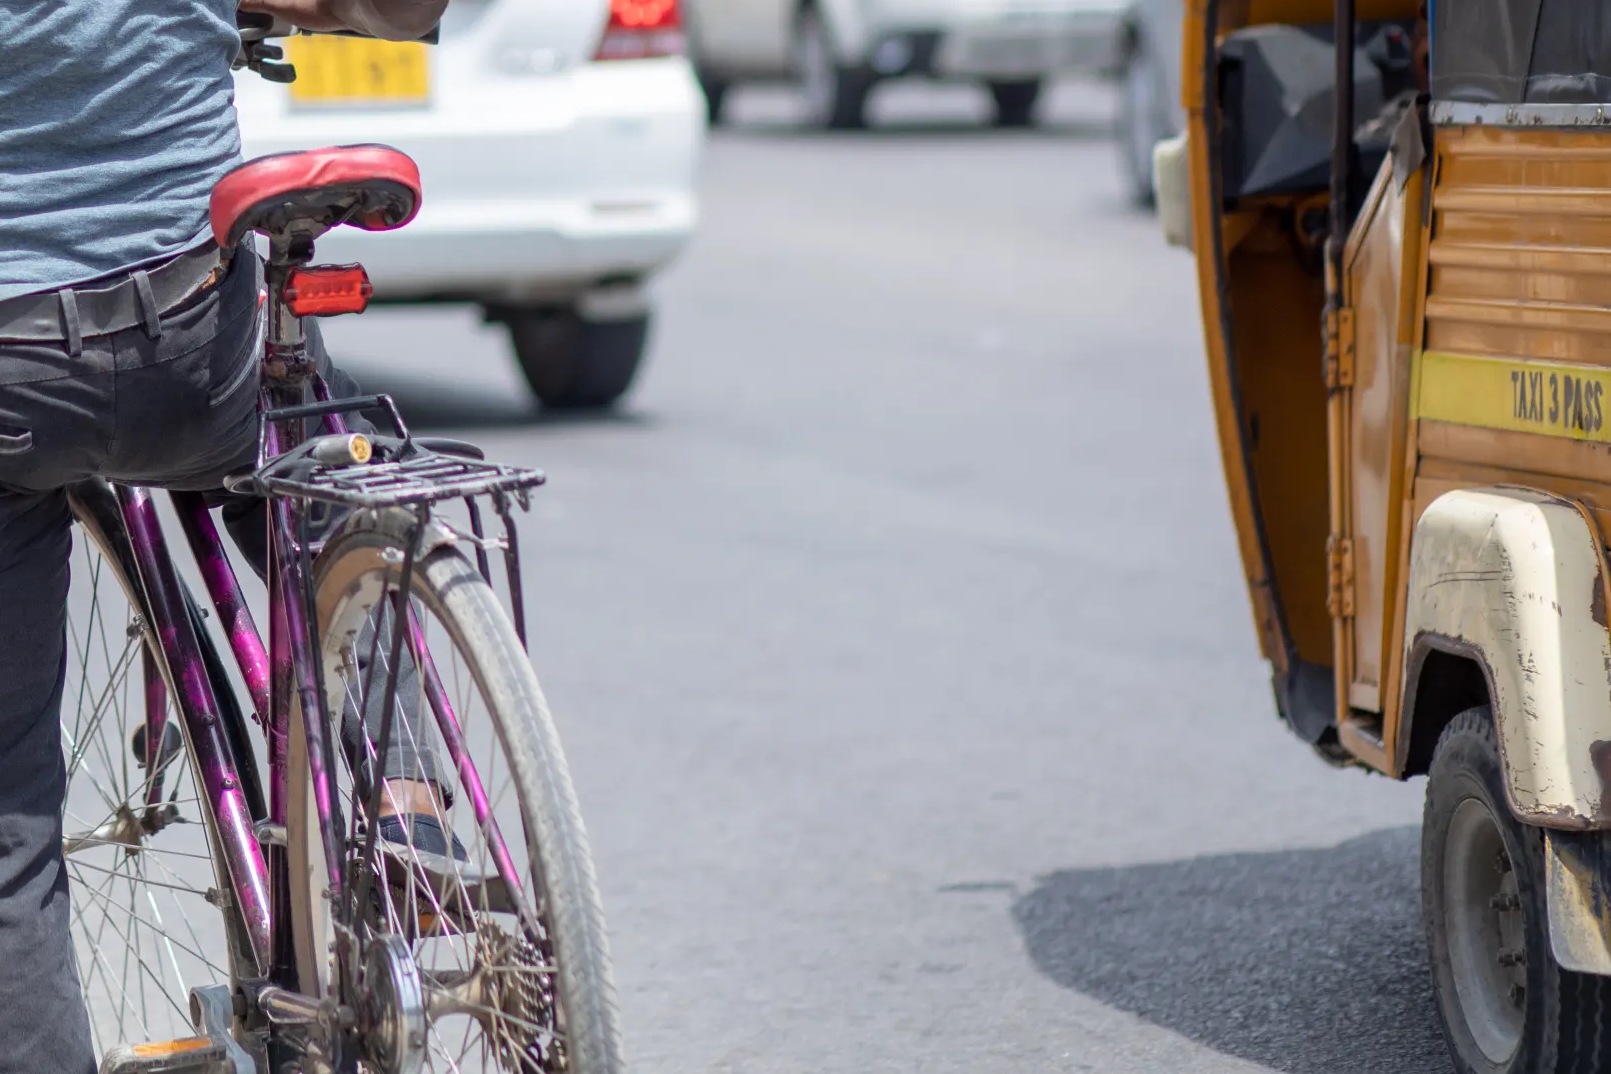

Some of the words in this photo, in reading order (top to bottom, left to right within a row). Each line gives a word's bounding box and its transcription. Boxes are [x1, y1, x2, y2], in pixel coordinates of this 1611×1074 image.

[1511, 370, 1544, 423] TAXI
[1549, 372, 1559, 424] 3
[1563, 374, 1604, 434] PASS
